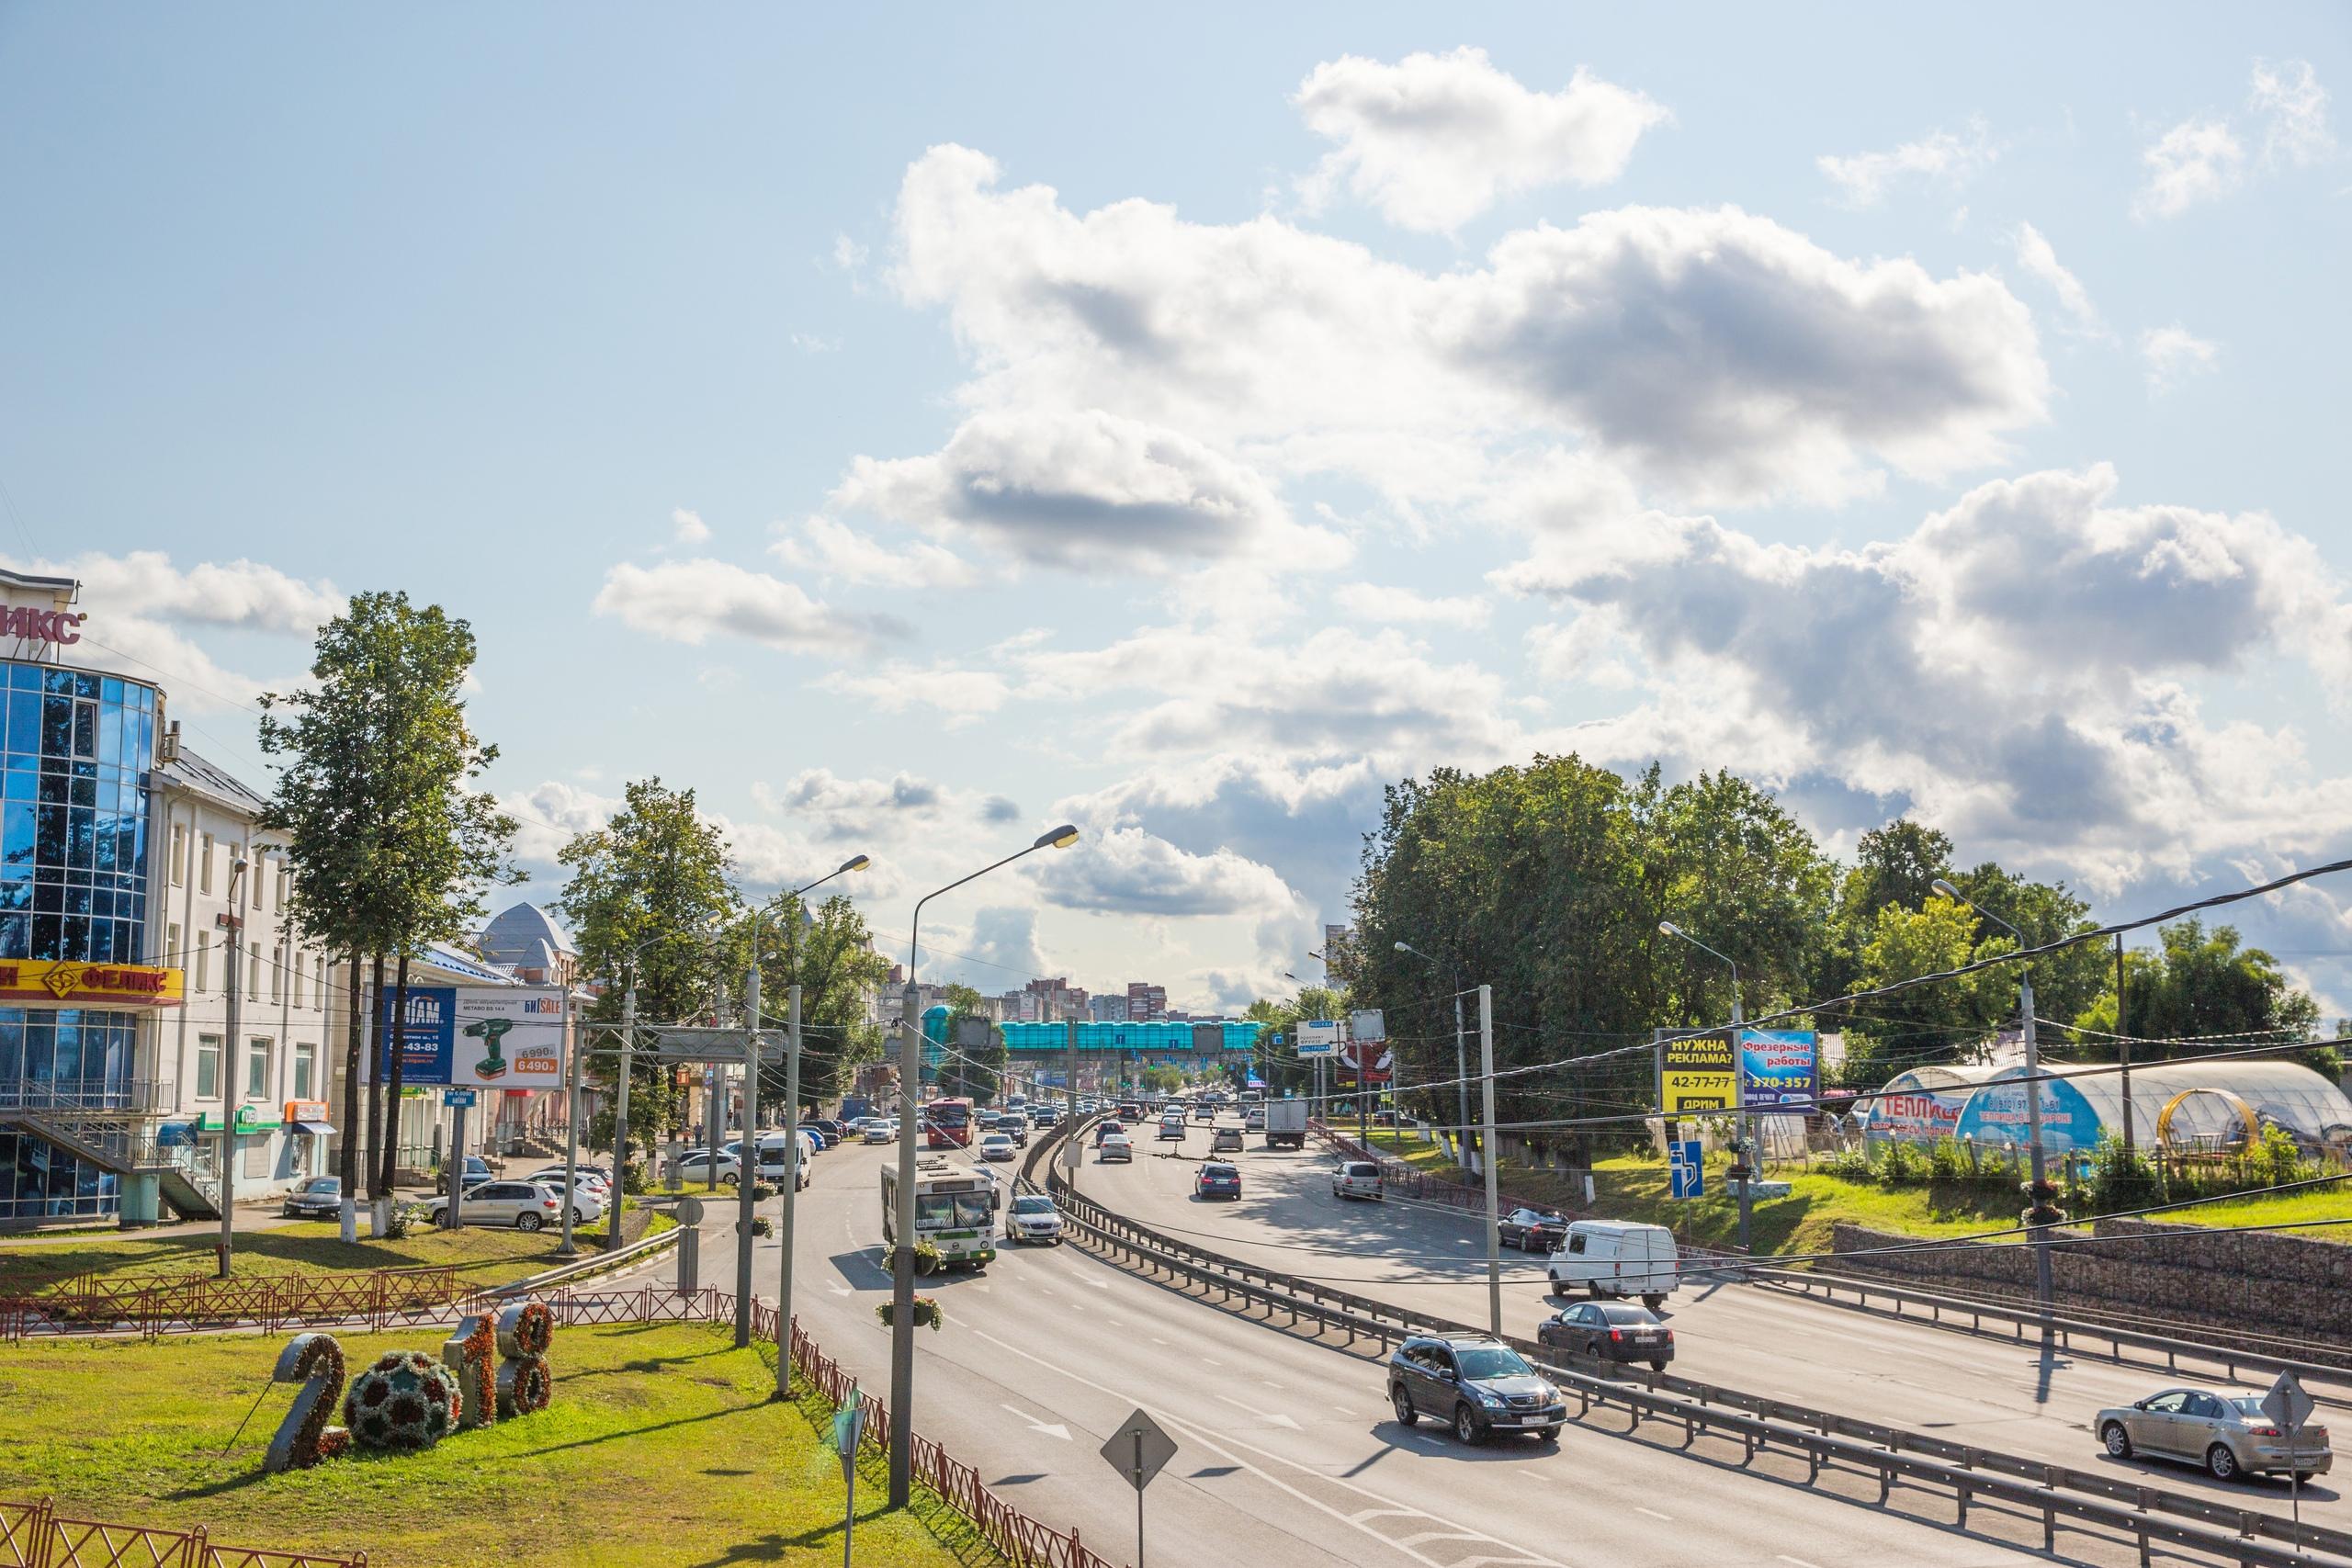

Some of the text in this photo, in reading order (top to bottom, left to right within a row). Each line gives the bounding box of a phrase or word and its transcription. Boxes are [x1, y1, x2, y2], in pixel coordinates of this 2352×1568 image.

[81, 967, 167, 992] ФЕЛИКС
[1671, 1040, 1728, 1052] НУЖНА
[1742, 1041, 1811, 1054] Фрезерные
[1667, 1053, 1734, 1065] РЕКЛАМА?
[1767, 1056, 1812, 1067] работы
[1671, 1077, 1730, 1088] 42-77-77
[1752, 1077, 1812, 1088] 370-357
[1683, 1099, 1720, 1110] ДРИМ
[1883, 1095, 1962, 1123] ТЕПЛИЦ
